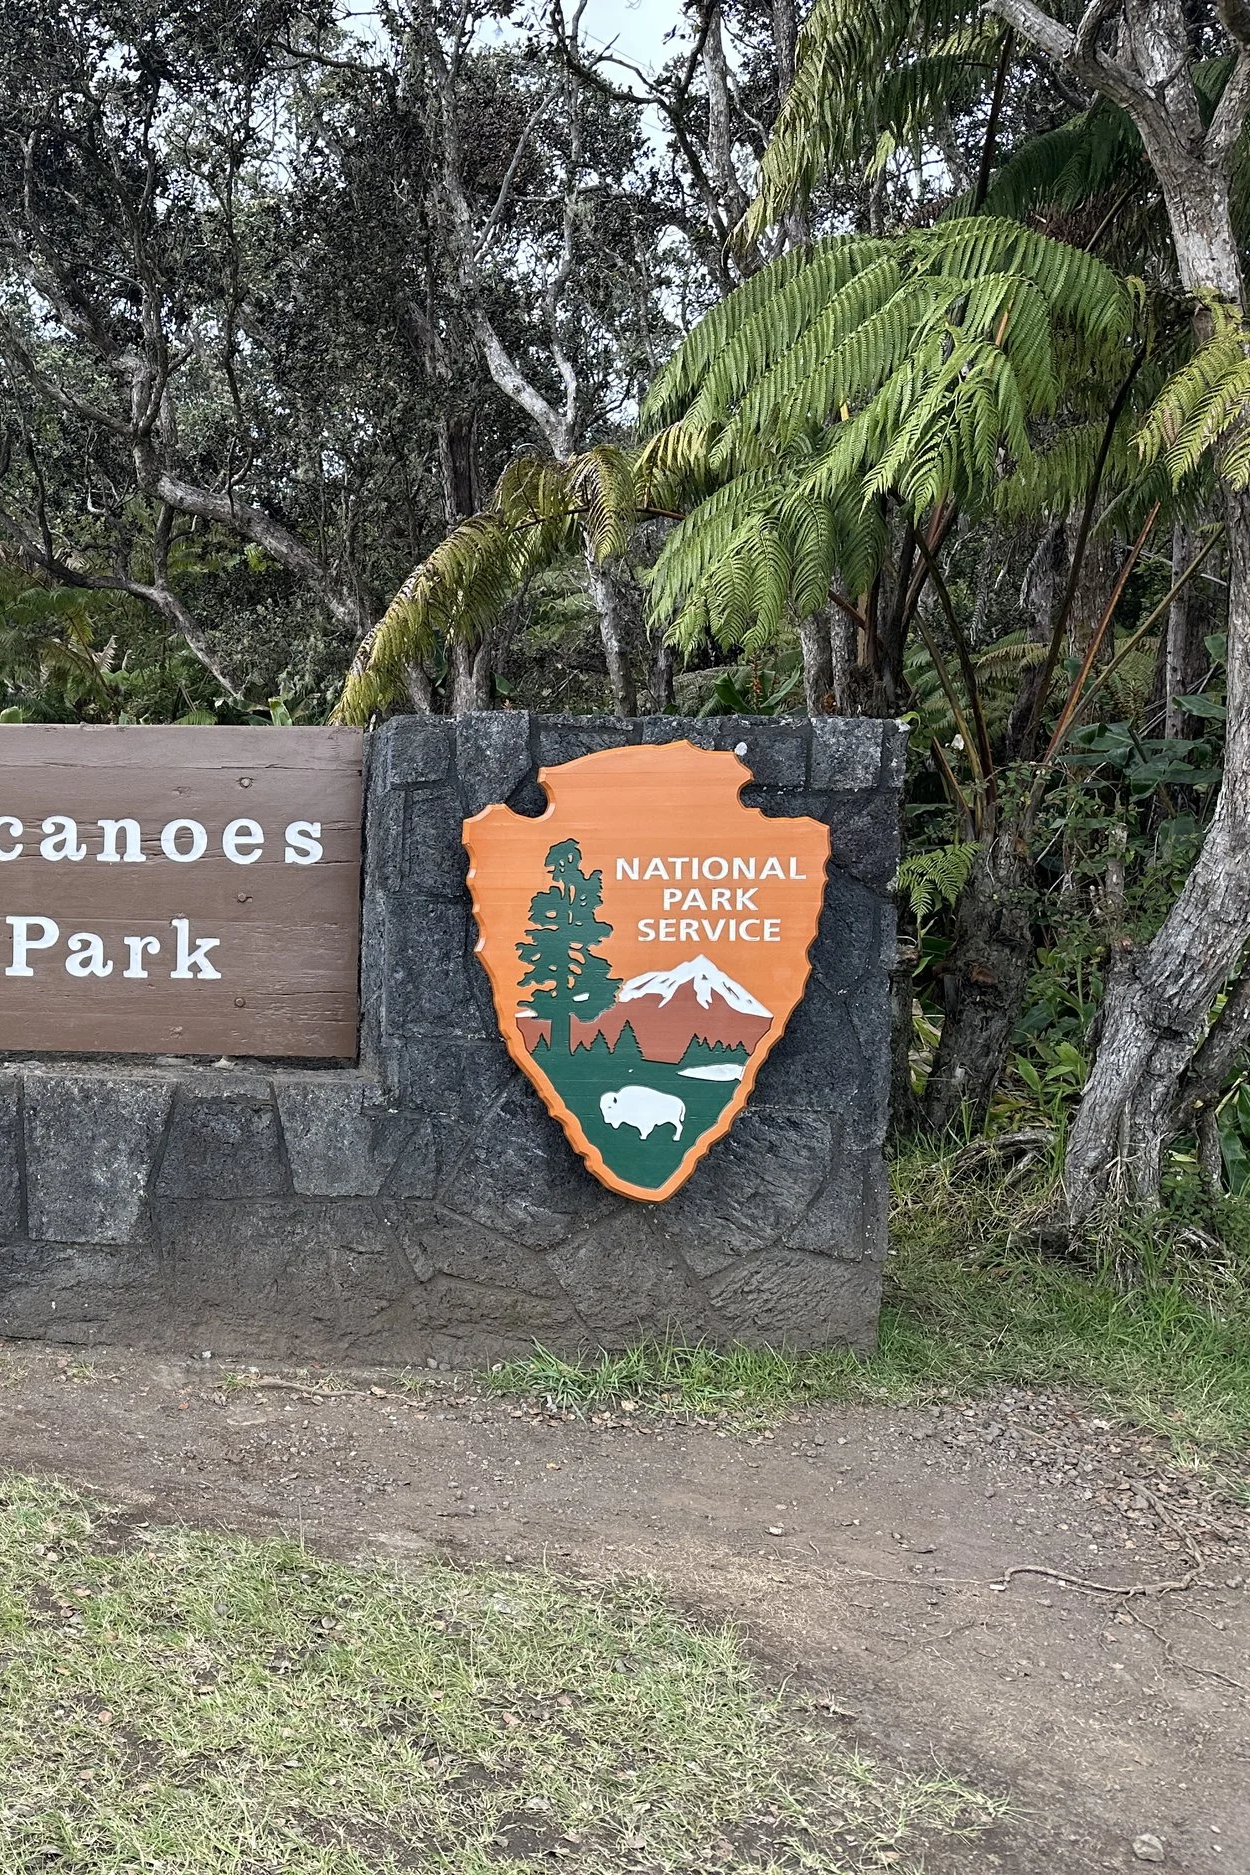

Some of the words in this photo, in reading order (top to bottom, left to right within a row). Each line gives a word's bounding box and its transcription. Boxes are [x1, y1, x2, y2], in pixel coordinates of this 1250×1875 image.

[615, 856, 807, 881] NATIONAL
[663, 887, 759, 912] PARK
[637, 918, 781, 943] SERVICE
[5, 915, 222, 980] Park
